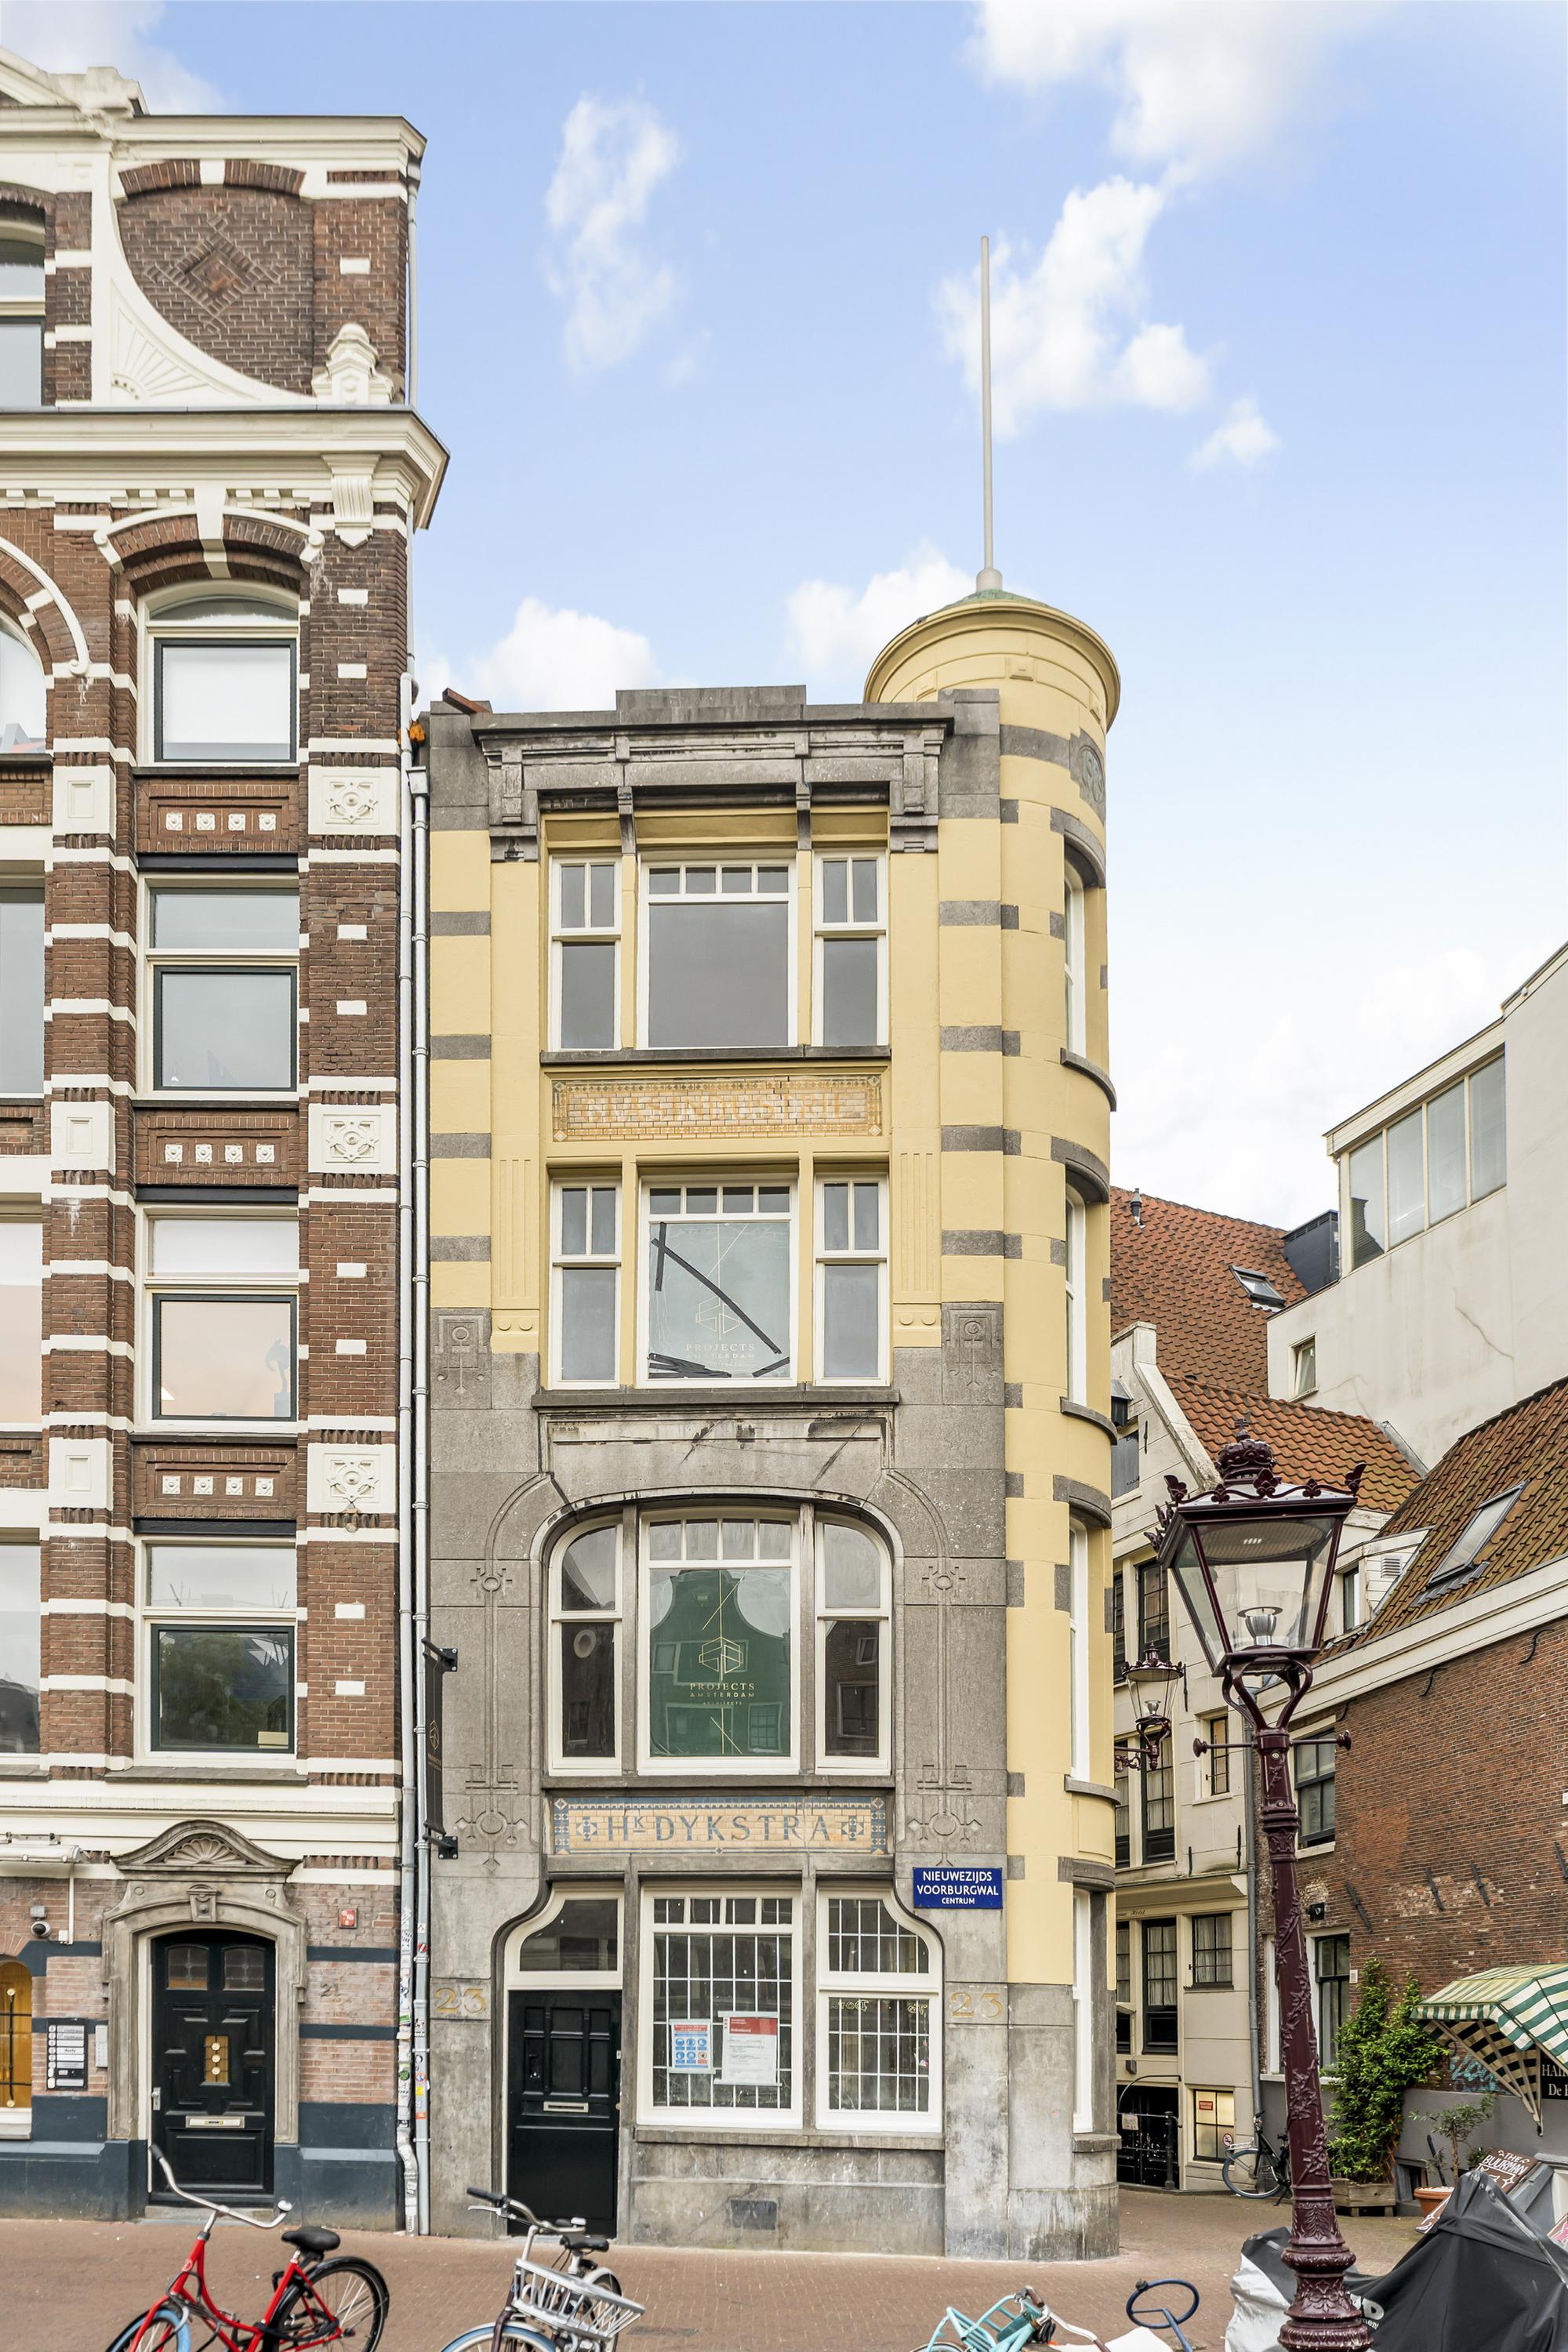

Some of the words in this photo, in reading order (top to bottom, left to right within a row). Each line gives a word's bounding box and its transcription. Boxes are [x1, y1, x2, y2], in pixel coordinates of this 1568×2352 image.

[686, 1343, 754, 1352] PROJECTS
[655, 1815, 830, 1842] DYKSTRA
[923, 1871, 993, 1884] NIEUWEZIJDS
[916, 1885, 999, 1896] VOORBURGWAL
[435, 1987, 486, 2013] 23
[951, 1991, 1004, 2018] 23
[1548, 2083, 1562, 2096] De
[1504, 2152, 1522, 2162] THE
[1482, 2154, 1529, 2176] BUURMAN
